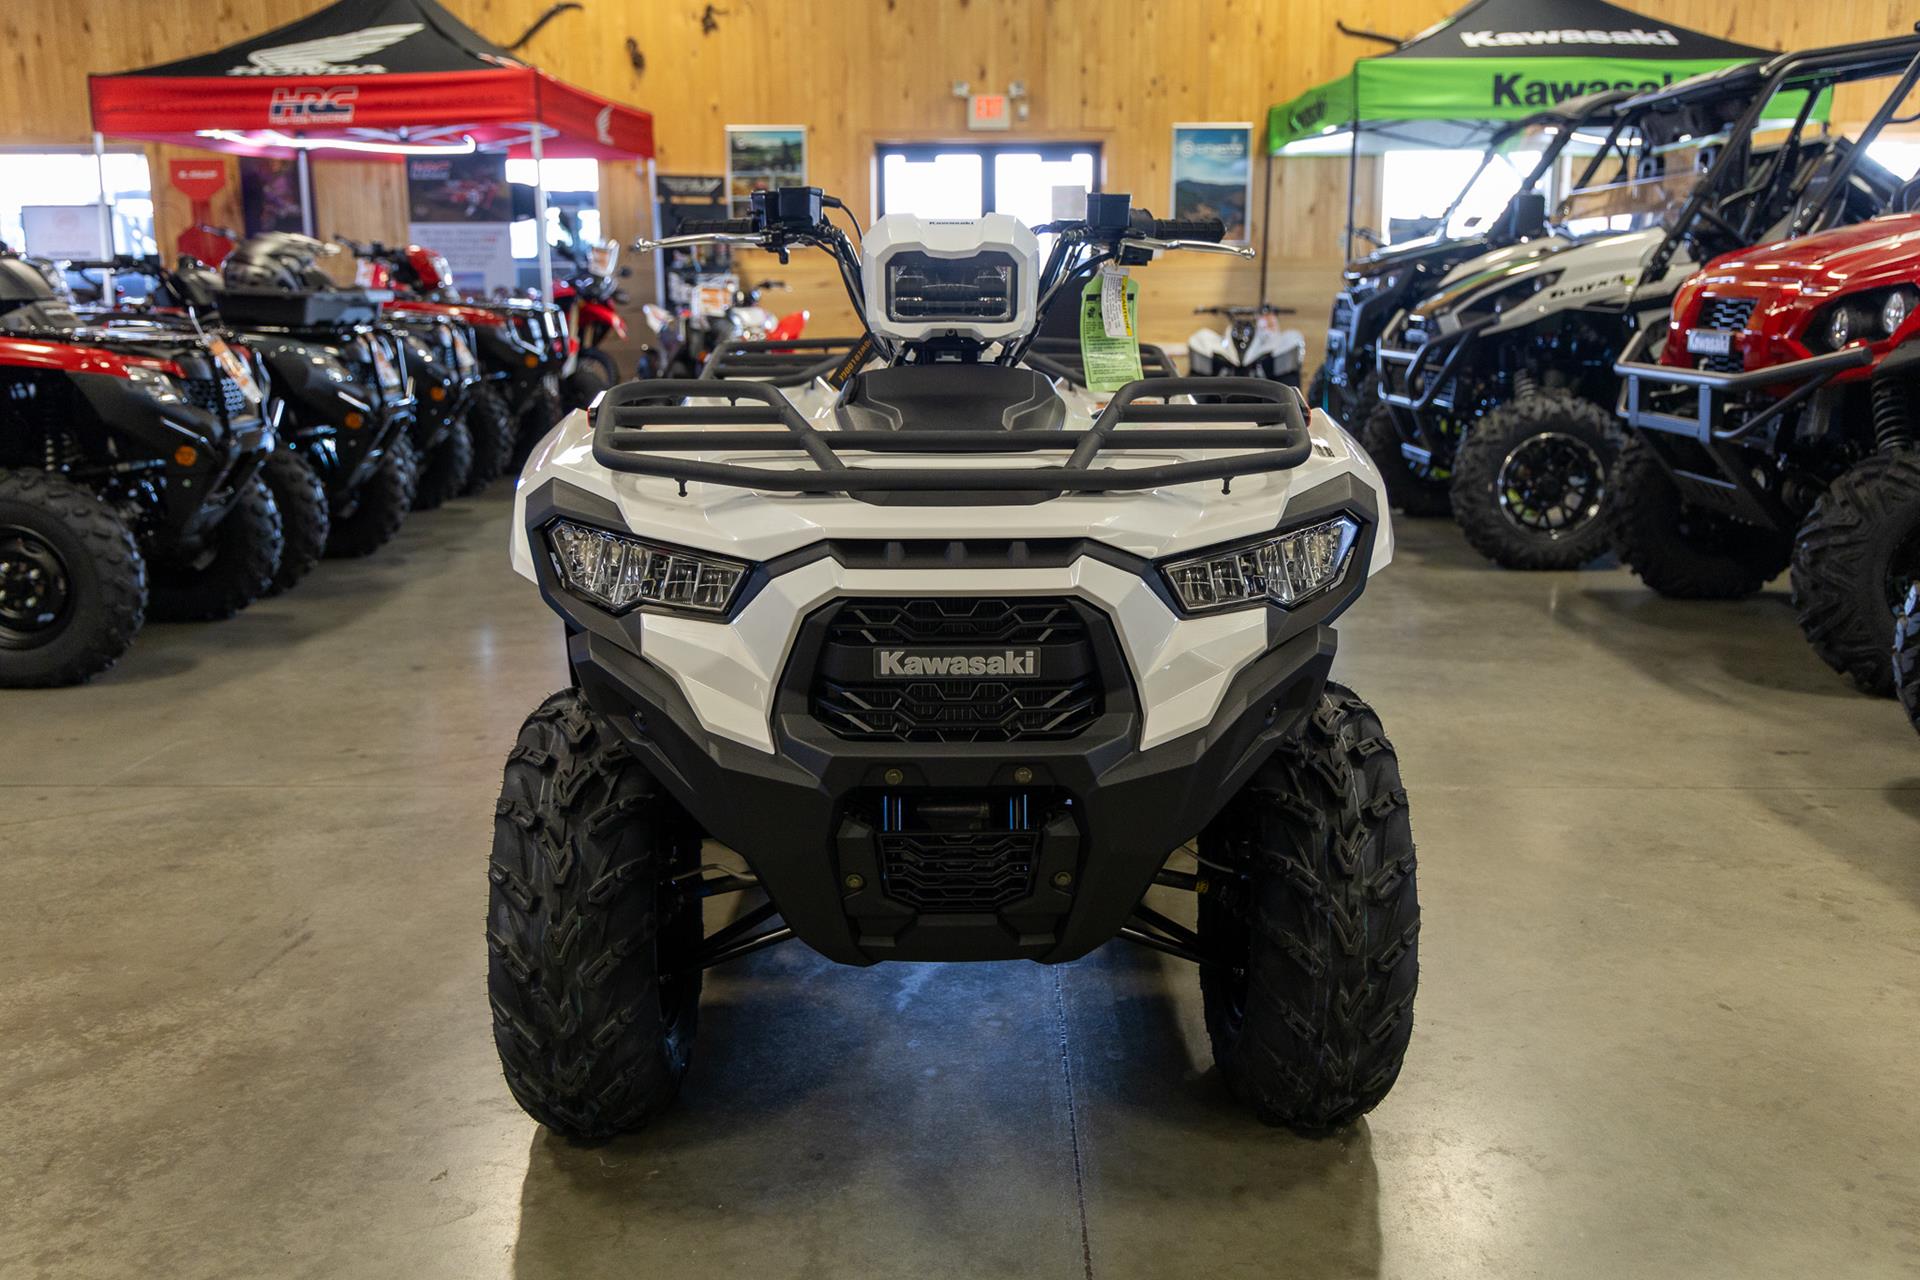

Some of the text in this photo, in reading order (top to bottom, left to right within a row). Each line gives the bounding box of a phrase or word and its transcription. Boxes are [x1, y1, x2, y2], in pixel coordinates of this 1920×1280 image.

[1459, 29, 1680, 48] Kawasaki
[269, 86, 359, 115] HRC
[1493, 71, 1700, 107] Kawaa
[975, 96, 1004, 119] EXIT
[1690, 333, 1729, 353] Kawasaki
[880, 651, 1034, 675] Kawasaki
